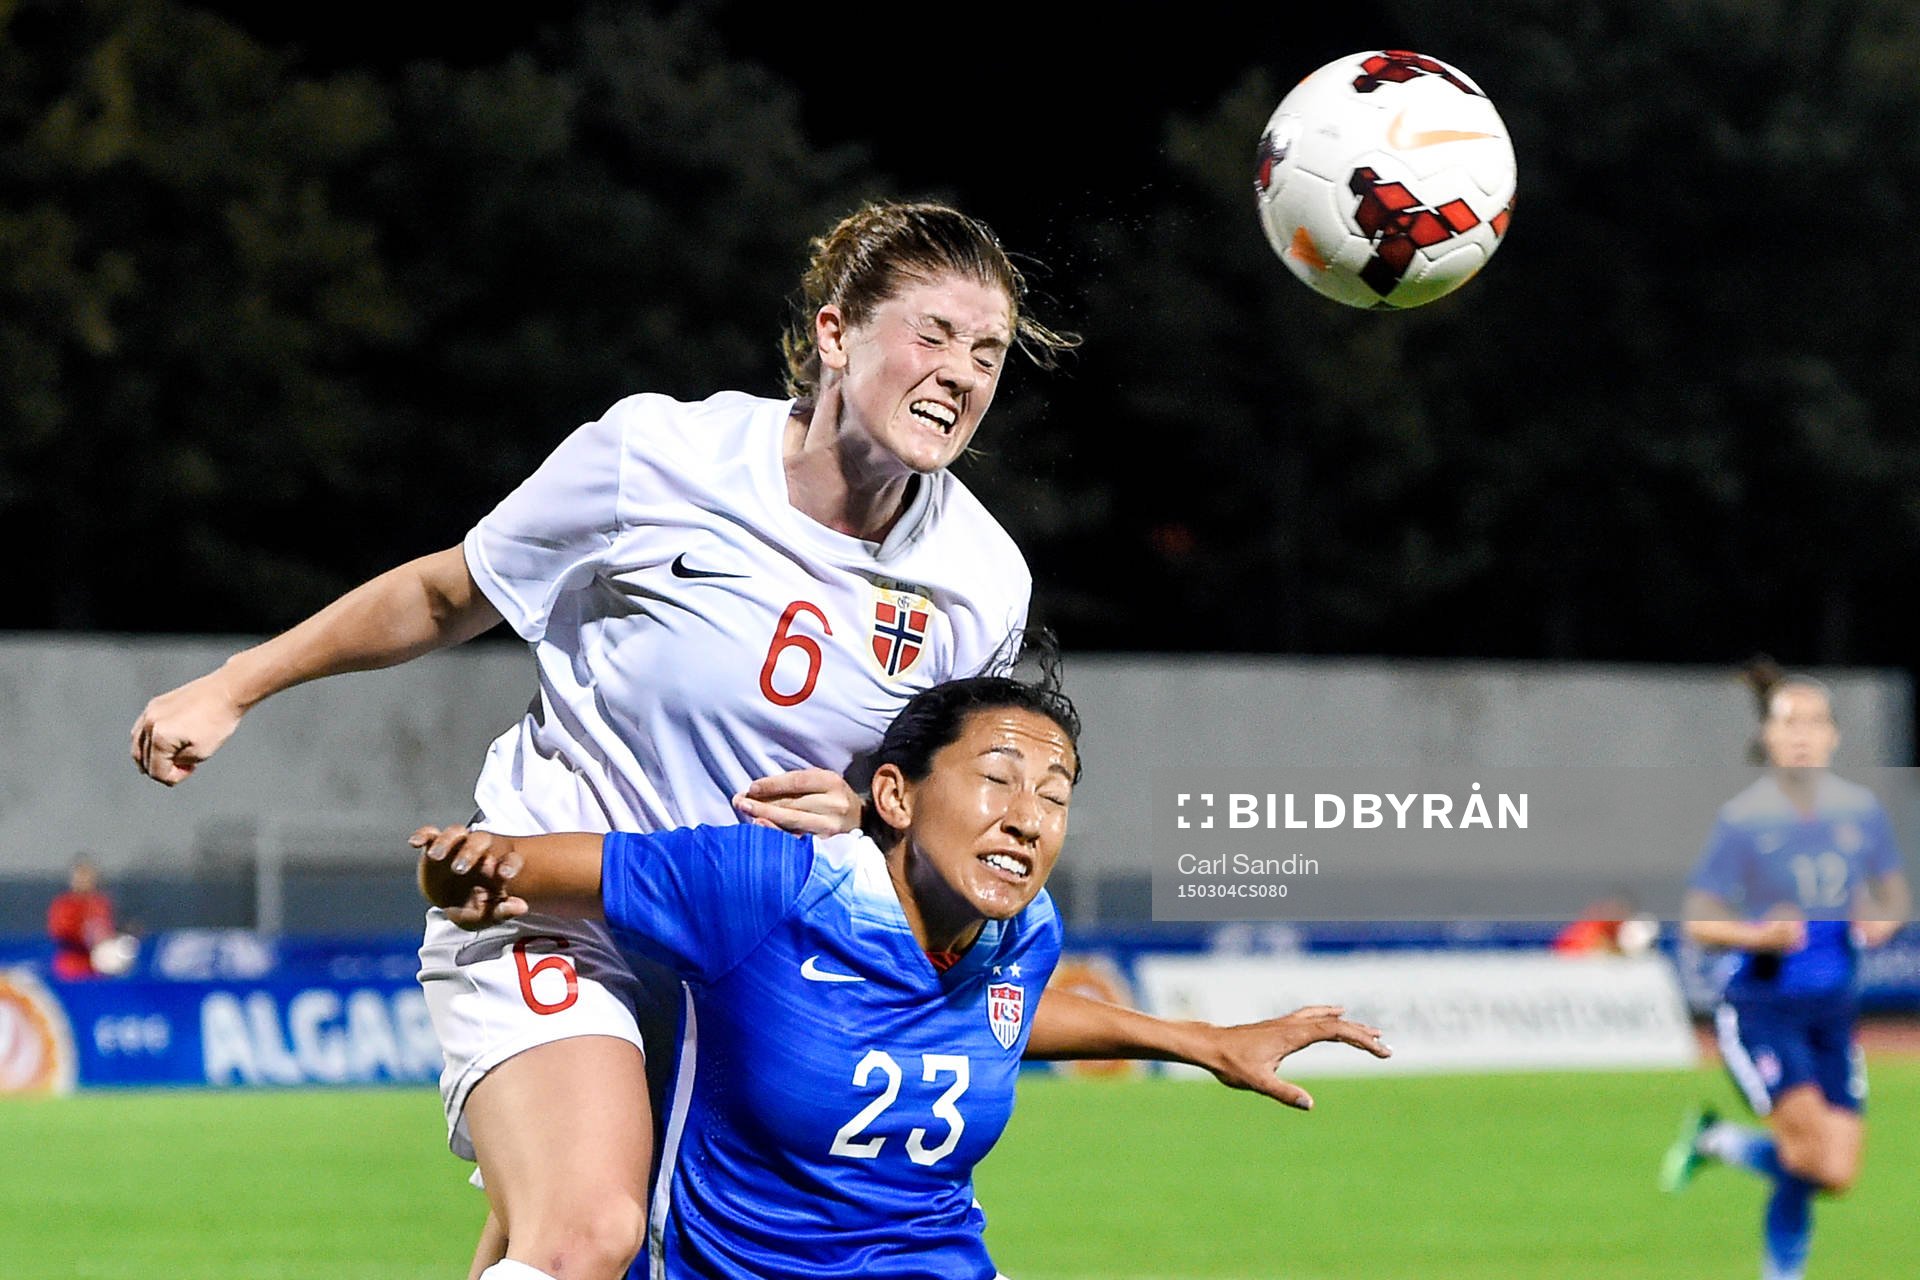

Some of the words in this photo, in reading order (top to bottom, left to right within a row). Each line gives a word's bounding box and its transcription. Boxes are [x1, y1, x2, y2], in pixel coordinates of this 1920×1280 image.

[759, 600, 833, 707] 6
[1791, 852, 1848, 908] 12
[513, 935, 579, 1016] 6
[829, 1049, 970, 1167] 23
